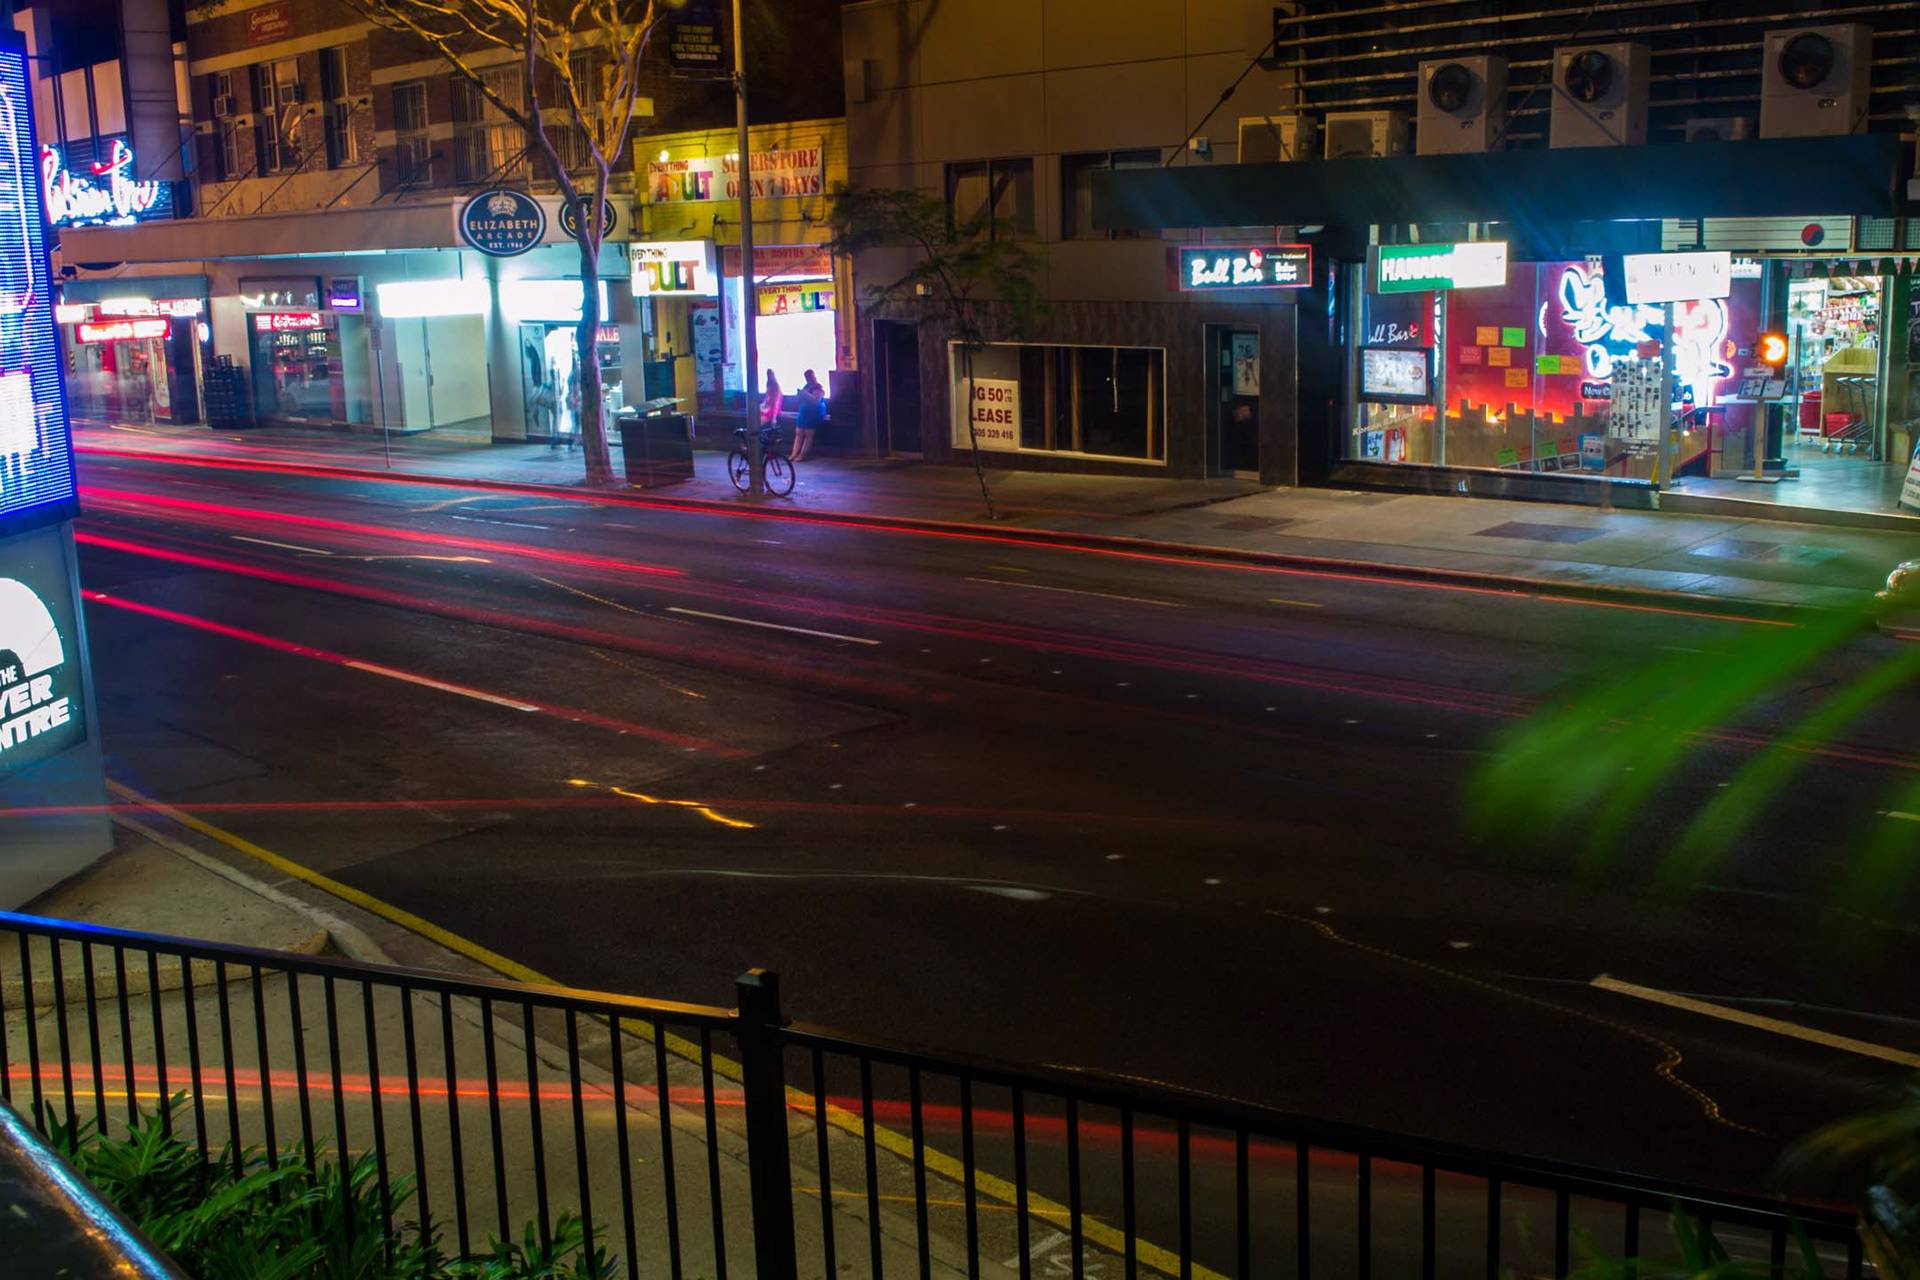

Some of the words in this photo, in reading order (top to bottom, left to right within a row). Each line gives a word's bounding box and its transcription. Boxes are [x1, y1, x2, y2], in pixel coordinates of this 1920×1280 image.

[722, 149, 819, 174] SUERSTORE
[656, 171, 713, 202] ADULT
[768, 178, 776, 196] 7
[782, 175, 820, 195] DAYS
[470, 219, 538, 230] ELIZABETH
[476, 231, 533, 240] ARCADE
[759, 285, 803, 295] EVERYTHING
[774, 291, 835, 314] AULT
[988, 388, 1003, 401] 50
